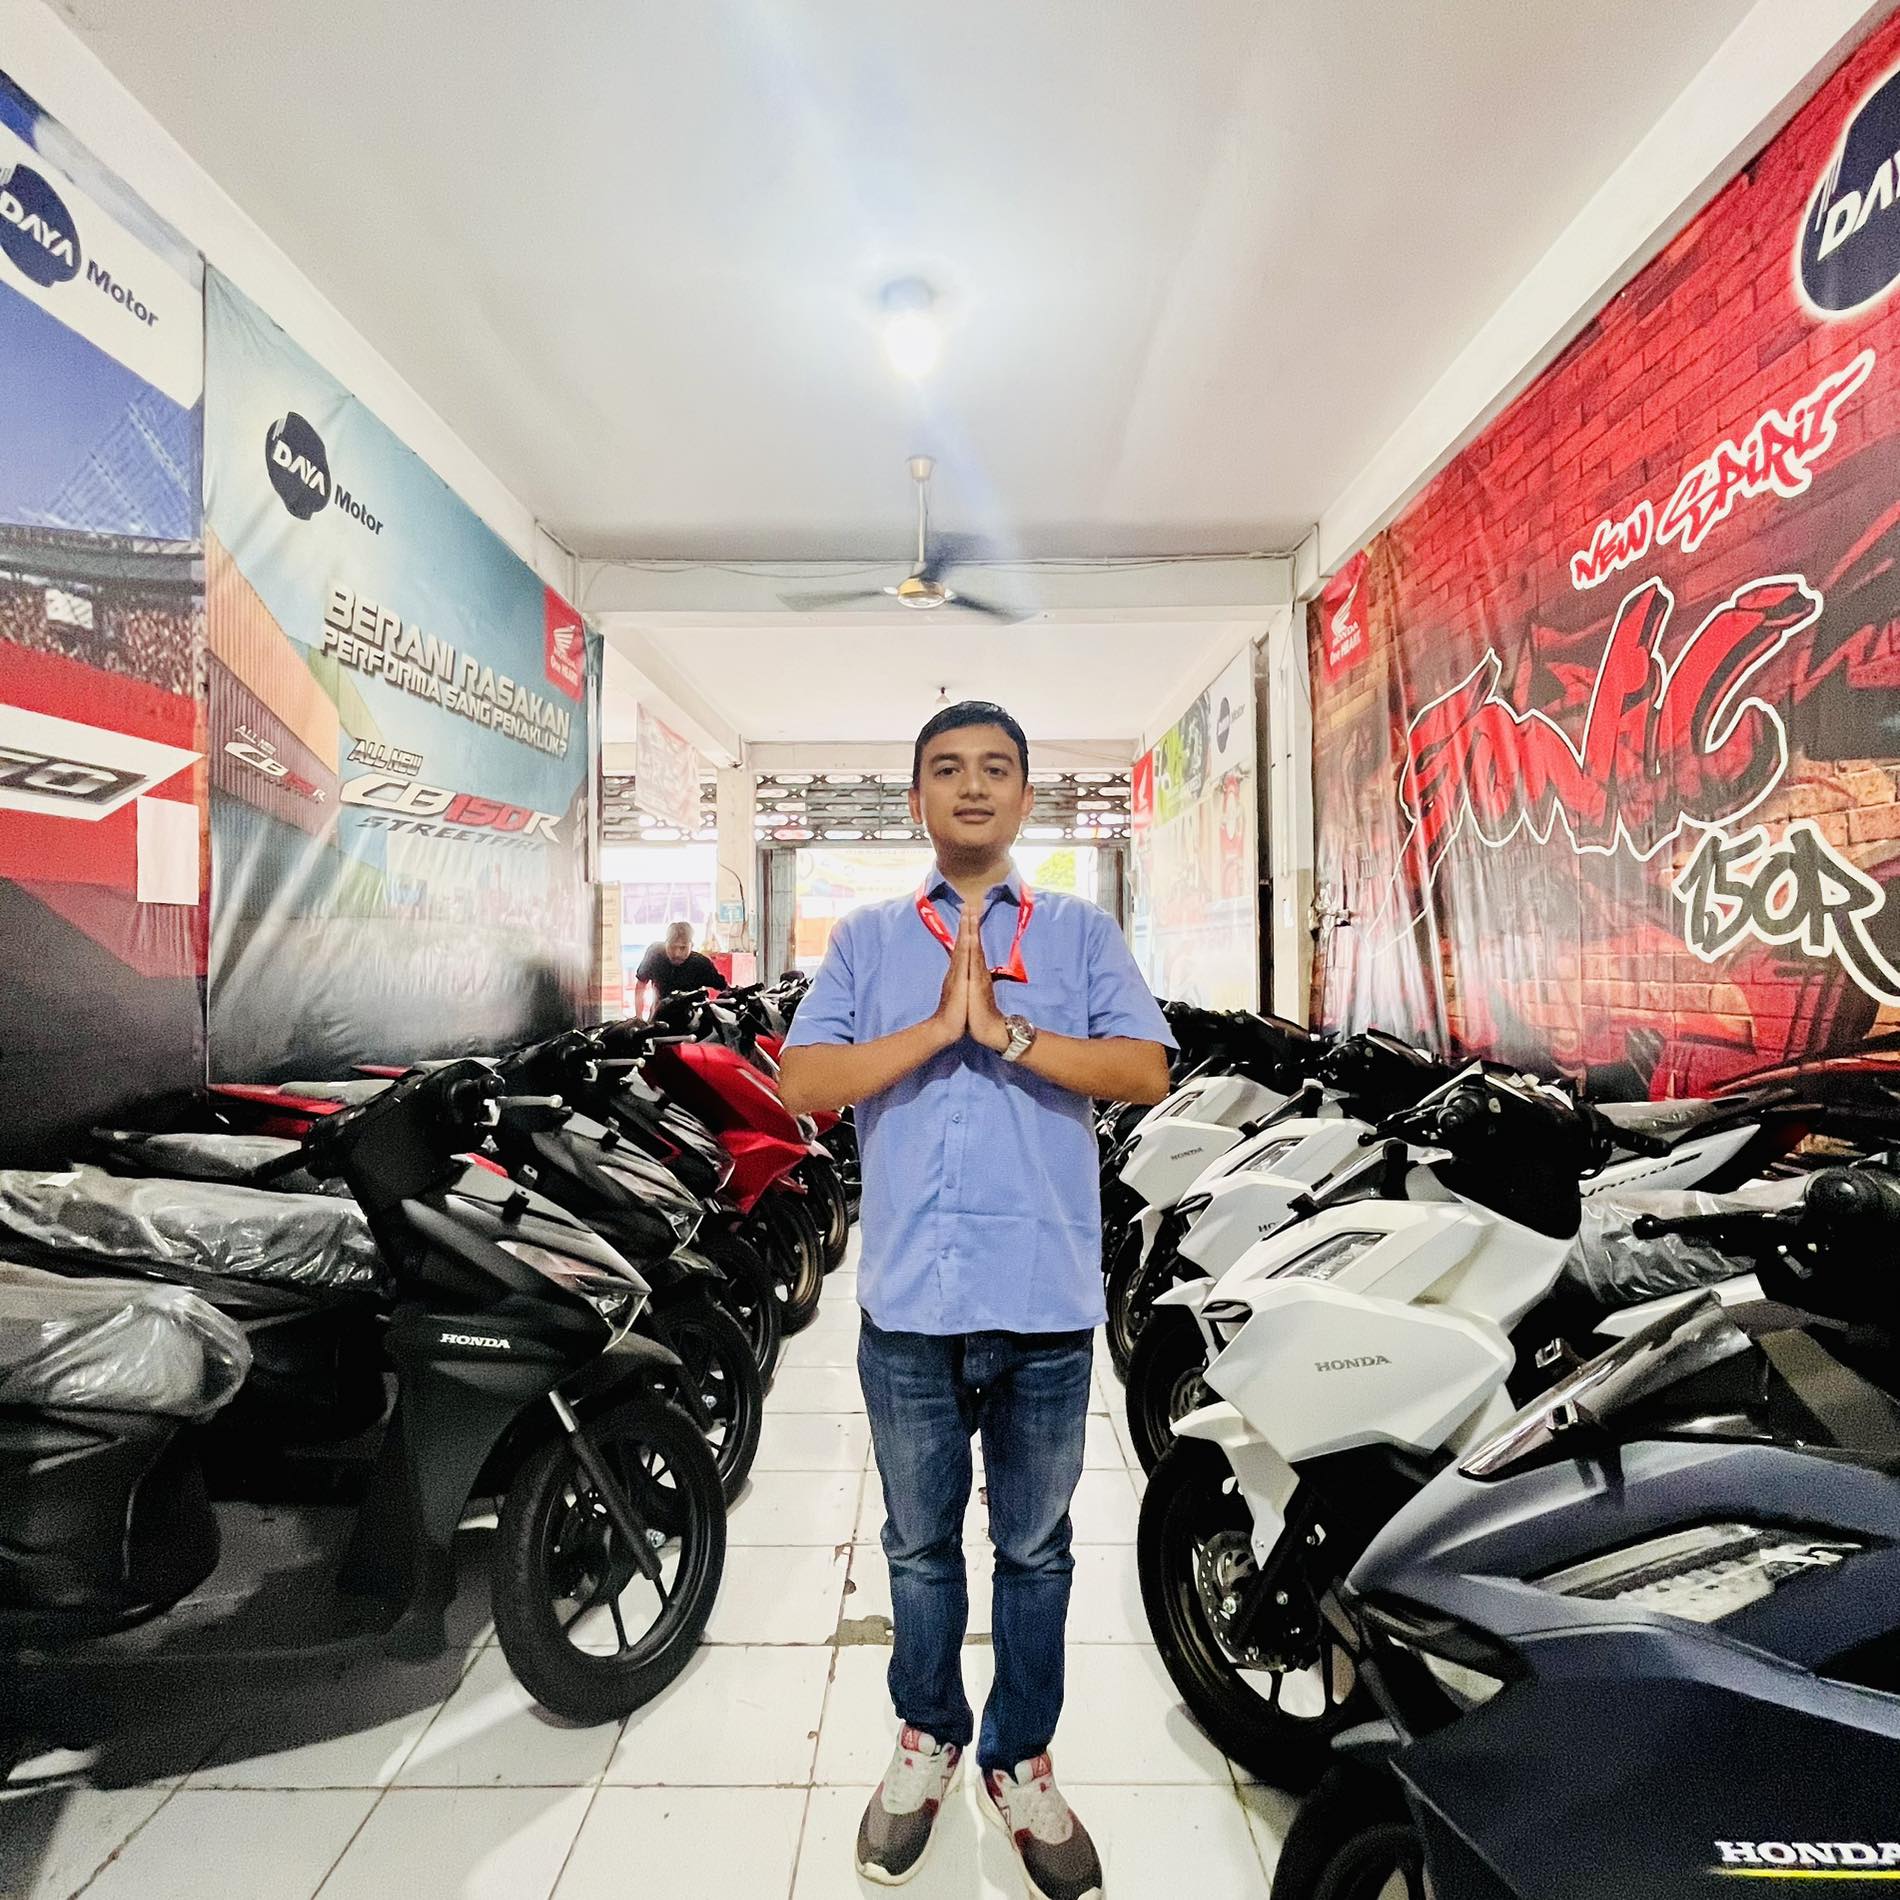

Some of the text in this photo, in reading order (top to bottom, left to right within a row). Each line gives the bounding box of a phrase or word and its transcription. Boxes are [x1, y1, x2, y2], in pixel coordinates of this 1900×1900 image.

[1817, 149, 1900, 261] DA
[0, 190, 159, 328] DAYA Motor
[272, 439, 384, 535] DAYA Motor
[1571, 502, 1652, 588] NEW
[320, 623, 442, 706] PERFORMA
[446, 683, 491, 729] SANG
[324, 584, 570, 740] BERANI RASAKAN
[347, 737, 424, 776] ALL NEW
[340, 772, 561, 843] CB150R
[1674, 819, 1900, 1006] 150R
[440, 1332, 511, 1349] HONDA
[1314, 1354, 1393, 1373] HONDA
